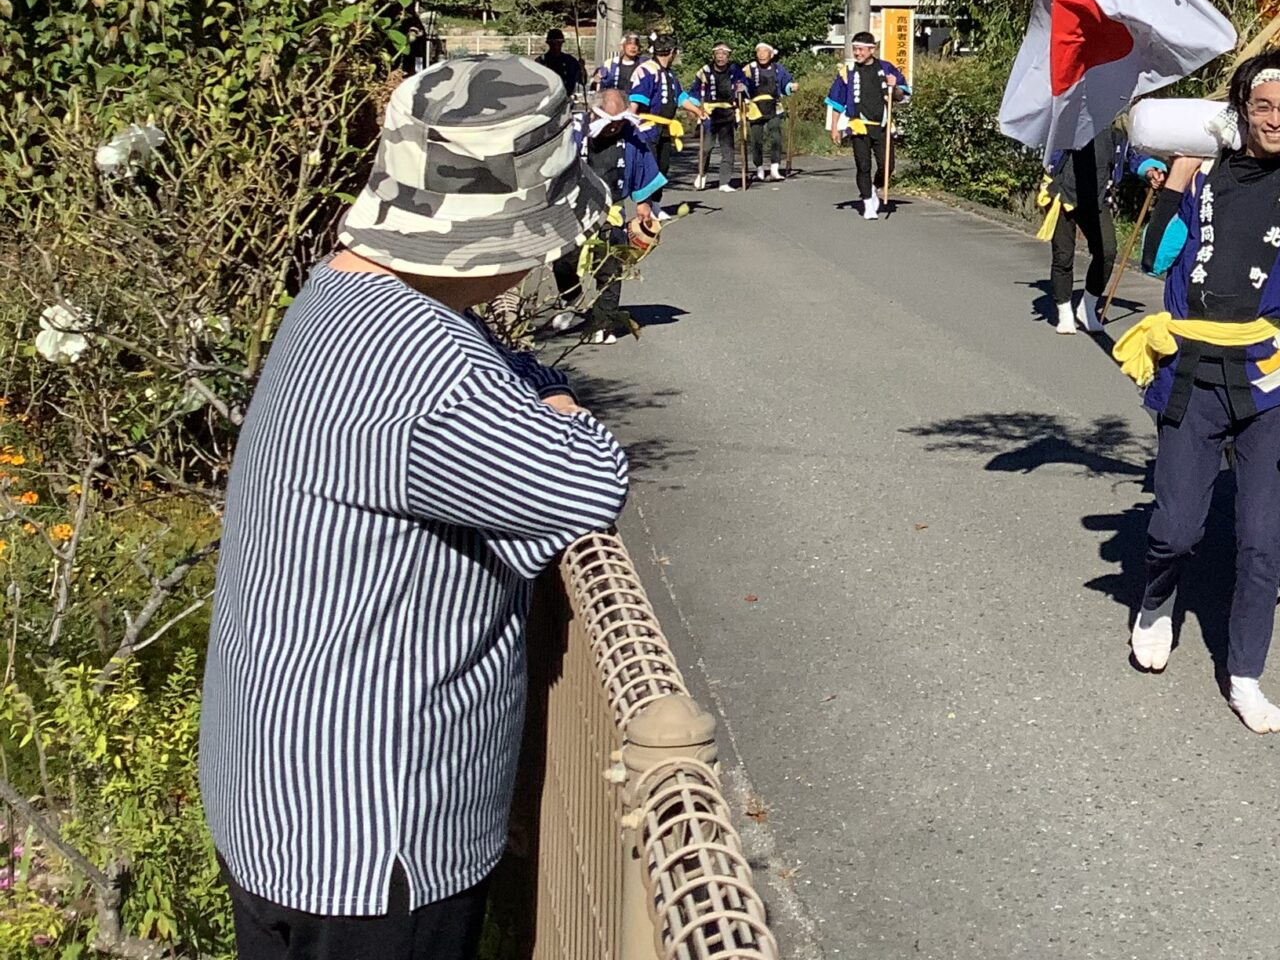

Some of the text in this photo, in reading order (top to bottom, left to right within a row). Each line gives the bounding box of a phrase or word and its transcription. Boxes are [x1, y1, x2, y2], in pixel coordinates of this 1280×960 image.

[1190, 184, 1215, 284] 長持同好会
